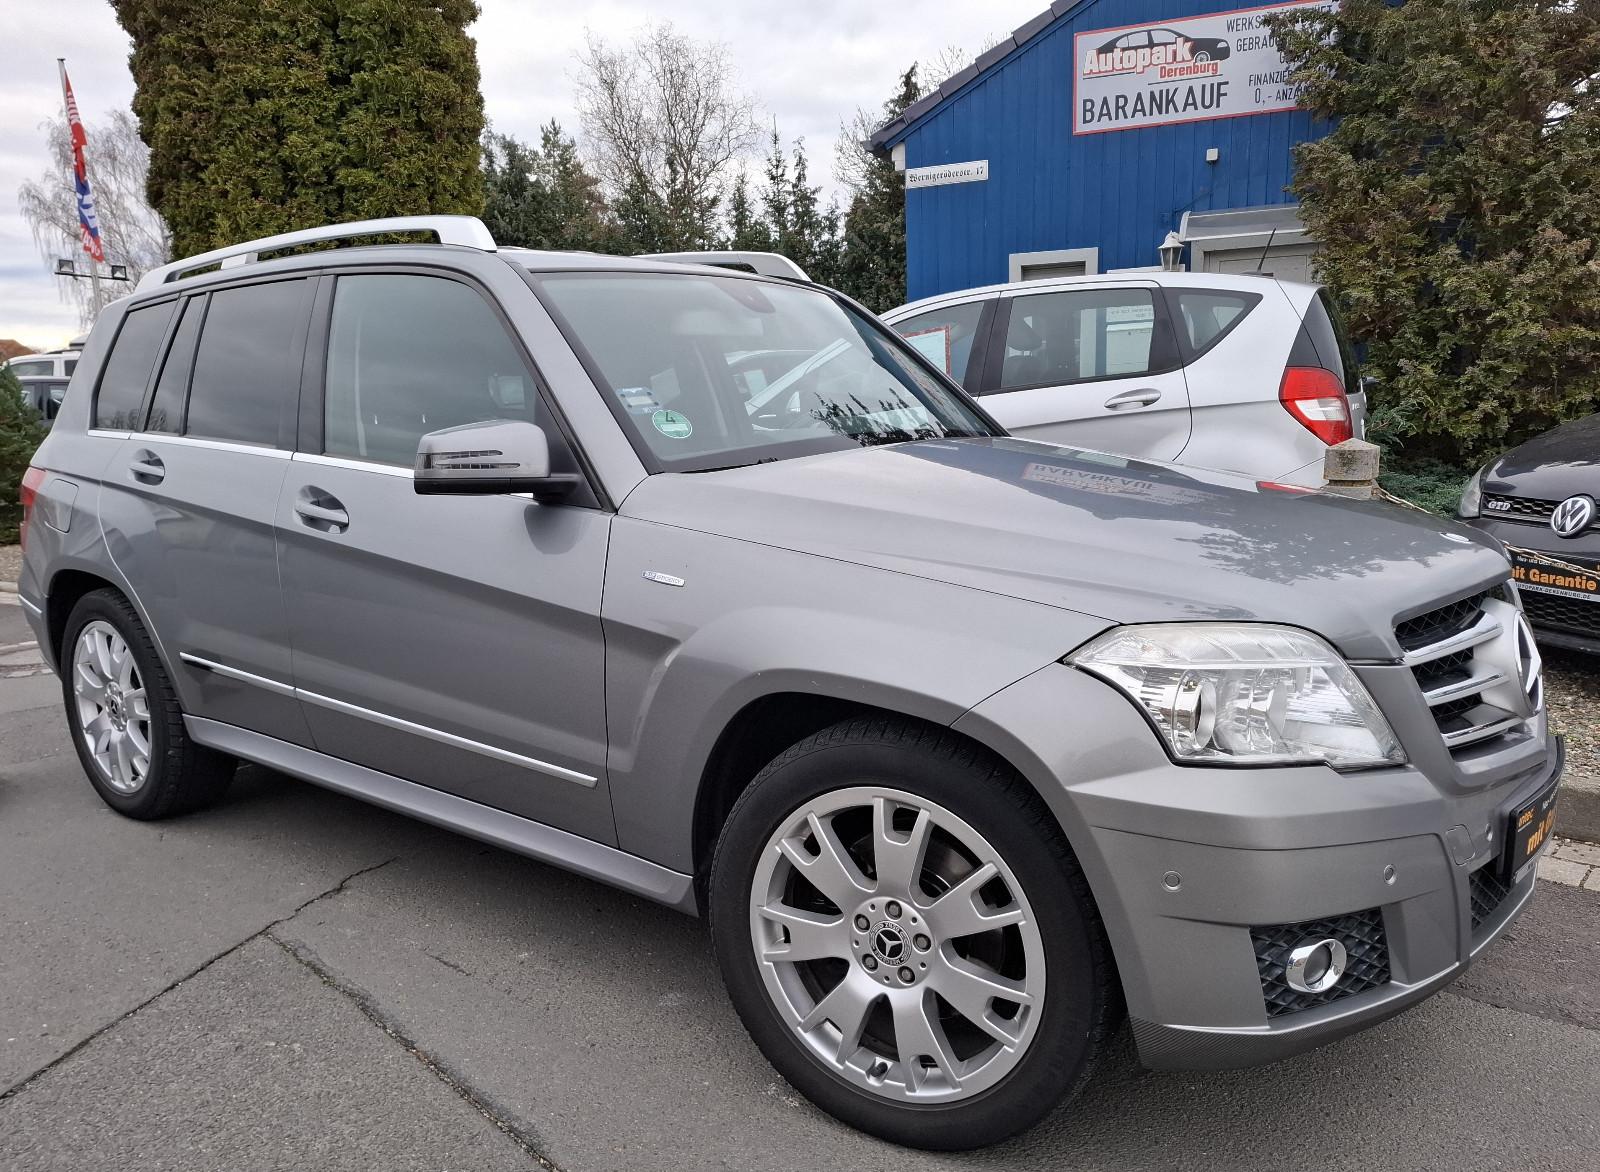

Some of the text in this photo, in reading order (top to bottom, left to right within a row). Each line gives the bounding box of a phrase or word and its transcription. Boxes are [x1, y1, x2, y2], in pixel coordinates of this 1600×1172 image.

[1083, 37, 1195, 75] Autopark
[1159, 61, 1219, 79] Derenburg
[1082, 81, 1230, 125] BARANKAUF
[1487, 500, 1511, 511] GTD
[1529, 568, 1597, 591] Garantie
